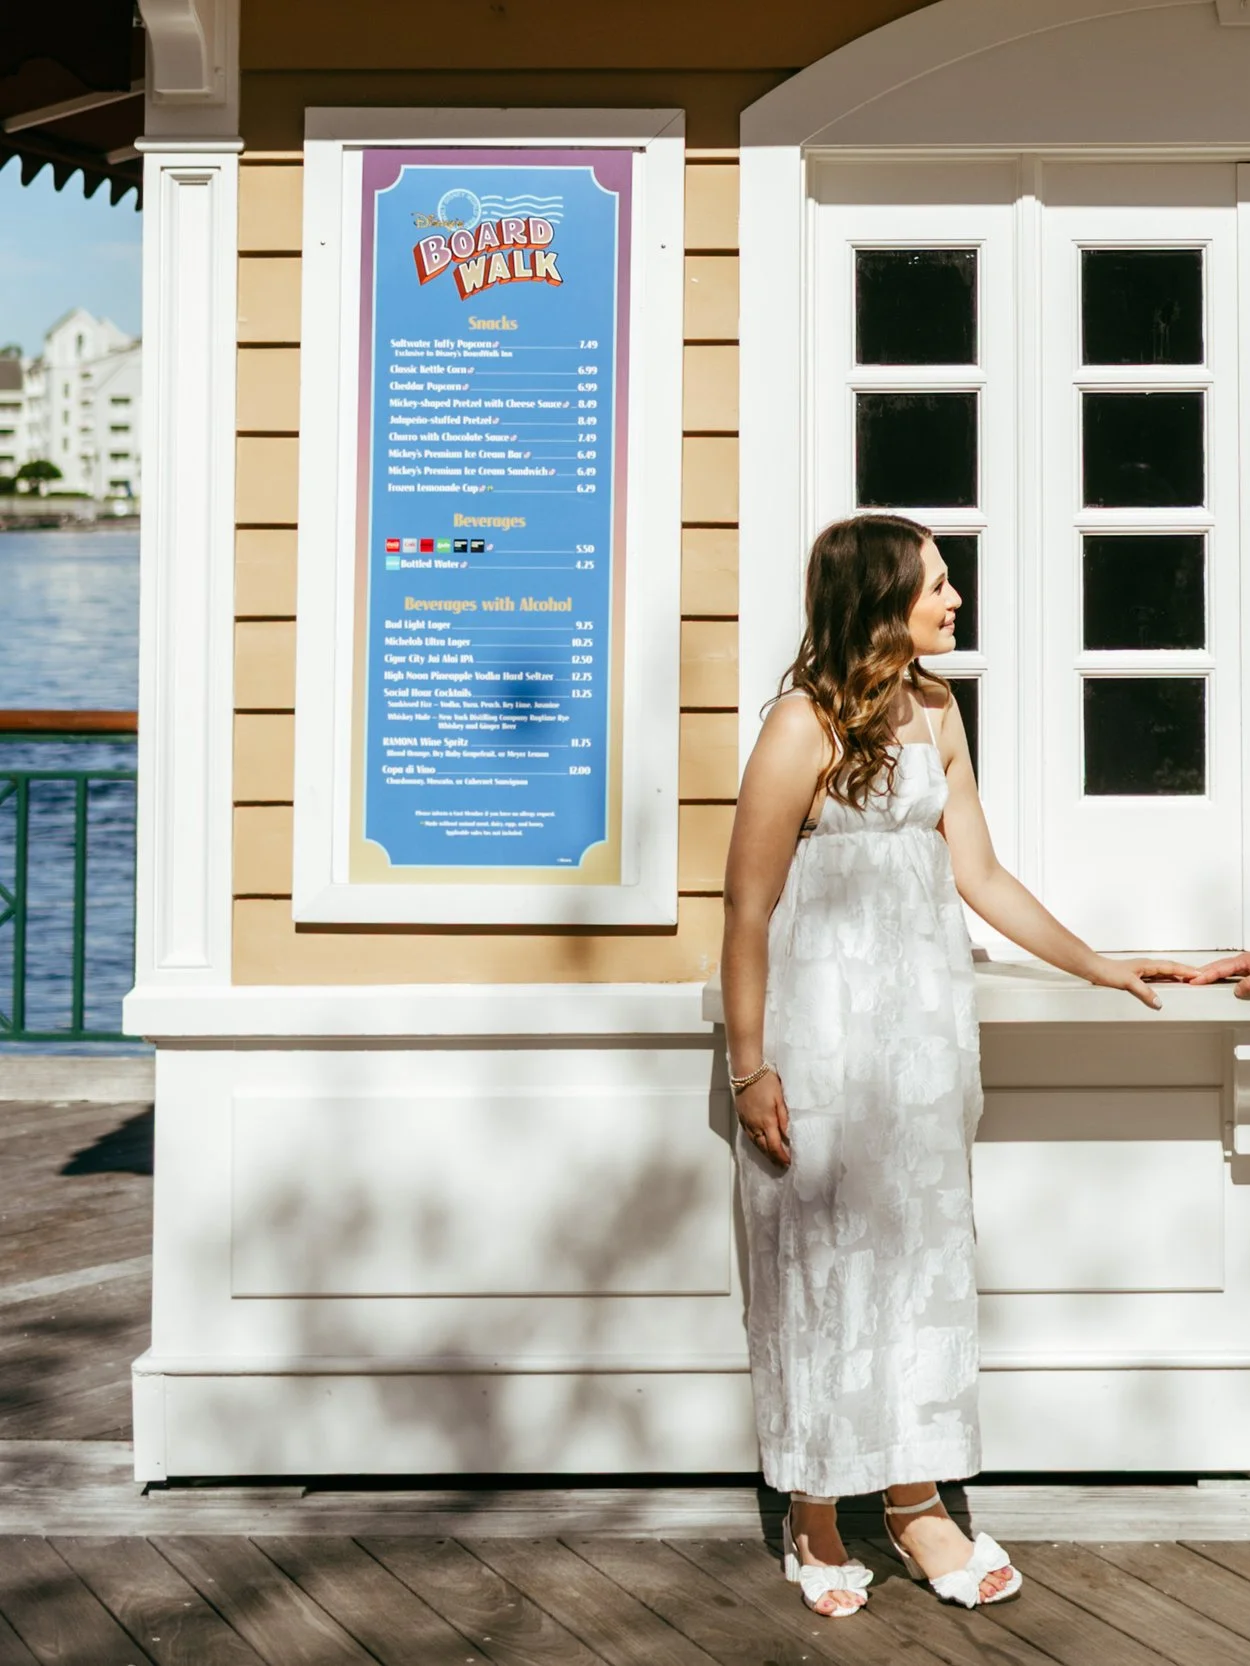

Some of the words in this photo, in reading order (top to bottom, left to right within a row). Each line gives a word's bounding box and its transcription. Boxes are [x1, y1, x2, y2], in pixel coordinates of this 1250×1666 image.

[413, 217, 554, 285] BOARD
[453, 250, 563, 301] WALK
[469, 315, 518, 330] Snacks
[390, 339, 431, 348] Saltwater
[434, 339, 455, 350] Taffy
[458, 339, 492, 350] Popcorn
[580, 340, 598, 349] 7.49
[390, 365, 417, 373] Classic
[420, 365, 444, 373] Kettle
[447, 365, 466, 374] Corn
[578, 366, 598, 375] 6.99
[390, 381, 424, 390] Cheddar
[427, 382, 461, 392] Popcorn
[578, 383, 598, 392] 6.99
[390, 398, 450, 409] Mickey-shaped
[453, 399, 481, 408] Pretzel
[484, 399, 503, 408] with
[506, 399, 535, 408] Cheese
[538, 400, 561, 408] Sauce
[578, 400, 597, 408] 8.49
[463, 416, 492, 424] Pretzel
[578, 416, 597, 425] 8.49
[389, 432, 417, 441] Churro
[420, 432, 439, 441] with
[442, 432, 483, 441] Chocolate
[485, 433, 509, 441] Sauce
[578, 434, 597, 442] 7.49
[424, 449, 462, 458] Premium
[465, 450, 476, 458] Ice
[479, 450, 505, 458] Cream
[508, 450, 523, 459] Bar
[577, 451, 596, 459] 6.49
[424, 466, 461, 475] Premium
[464, 467, 476, 475] Ice
[478, 467, 505, 475] Cream
[507, 467, 548, 476] Sandwich
[577, 467, 596, 476] 6.49
[388, 483, 415, 492] Frozen
[417, 483, 460, 492] Lemonade
[463, 484, 478, 494] Cup
[577, 484, 596, 493] 6.29
[454, 513, 526, 530] Beverages
[576, 545, 594, 553] 5.50
[401, 559, 432, 568] Bottled
[434, 560, 460, 568] Water
[576, 560, 594, 569] 4.25
[405, 596, 477, 614] Beverages
[482, 596, 514, 611] with
[520, 597, 572, 612] Alcohol
[385, 620, 402, 629] Bud
[405, 620, 425, 631] Light
[428, 620, 451, 631] Lager
[576, 621, 593, 630] 9.75
[385, 637, 423, 646] Michelob
[425, 637, 445, 646] Ultra
[448, 637, 471, 648] Lager
[572, 638, 593, 647] 10.75
[385, 654, 406, 664] Cigar
[409, 654, 425, 664] City
[461, 654, 474, 663] IPA
[572, 655, 593, 664] 12.50
[384, 671, 404, 681] High
[406, 671, 428, 680] Noon
[431, 671, 472, 682] Pineapple
[475, 672, 500, 680] Vodka
[503, 672, 523, 680] Hard
[526, 672, 553, 681] Seltzer
[572, 672, 592, 681] 12.75
[384, 688, 409, 697] Social
[412, 688, 432, 697] Hour
[435, 688, 472, 697] Cocktails
[572, 689, 592, 698] 13.25
[383, 737, 417, 746] RAMONA
[420, 737, 442, 746] Wine
[444, 738, 468, 748] Spritz
[571, 738, 591, 747] 11.75
[382, 765, 403, 775] Copa
[406, 765, 414, 774] di
[417, 765, 435, 774] Vino
[569, 766, 591, 775] 12.00
